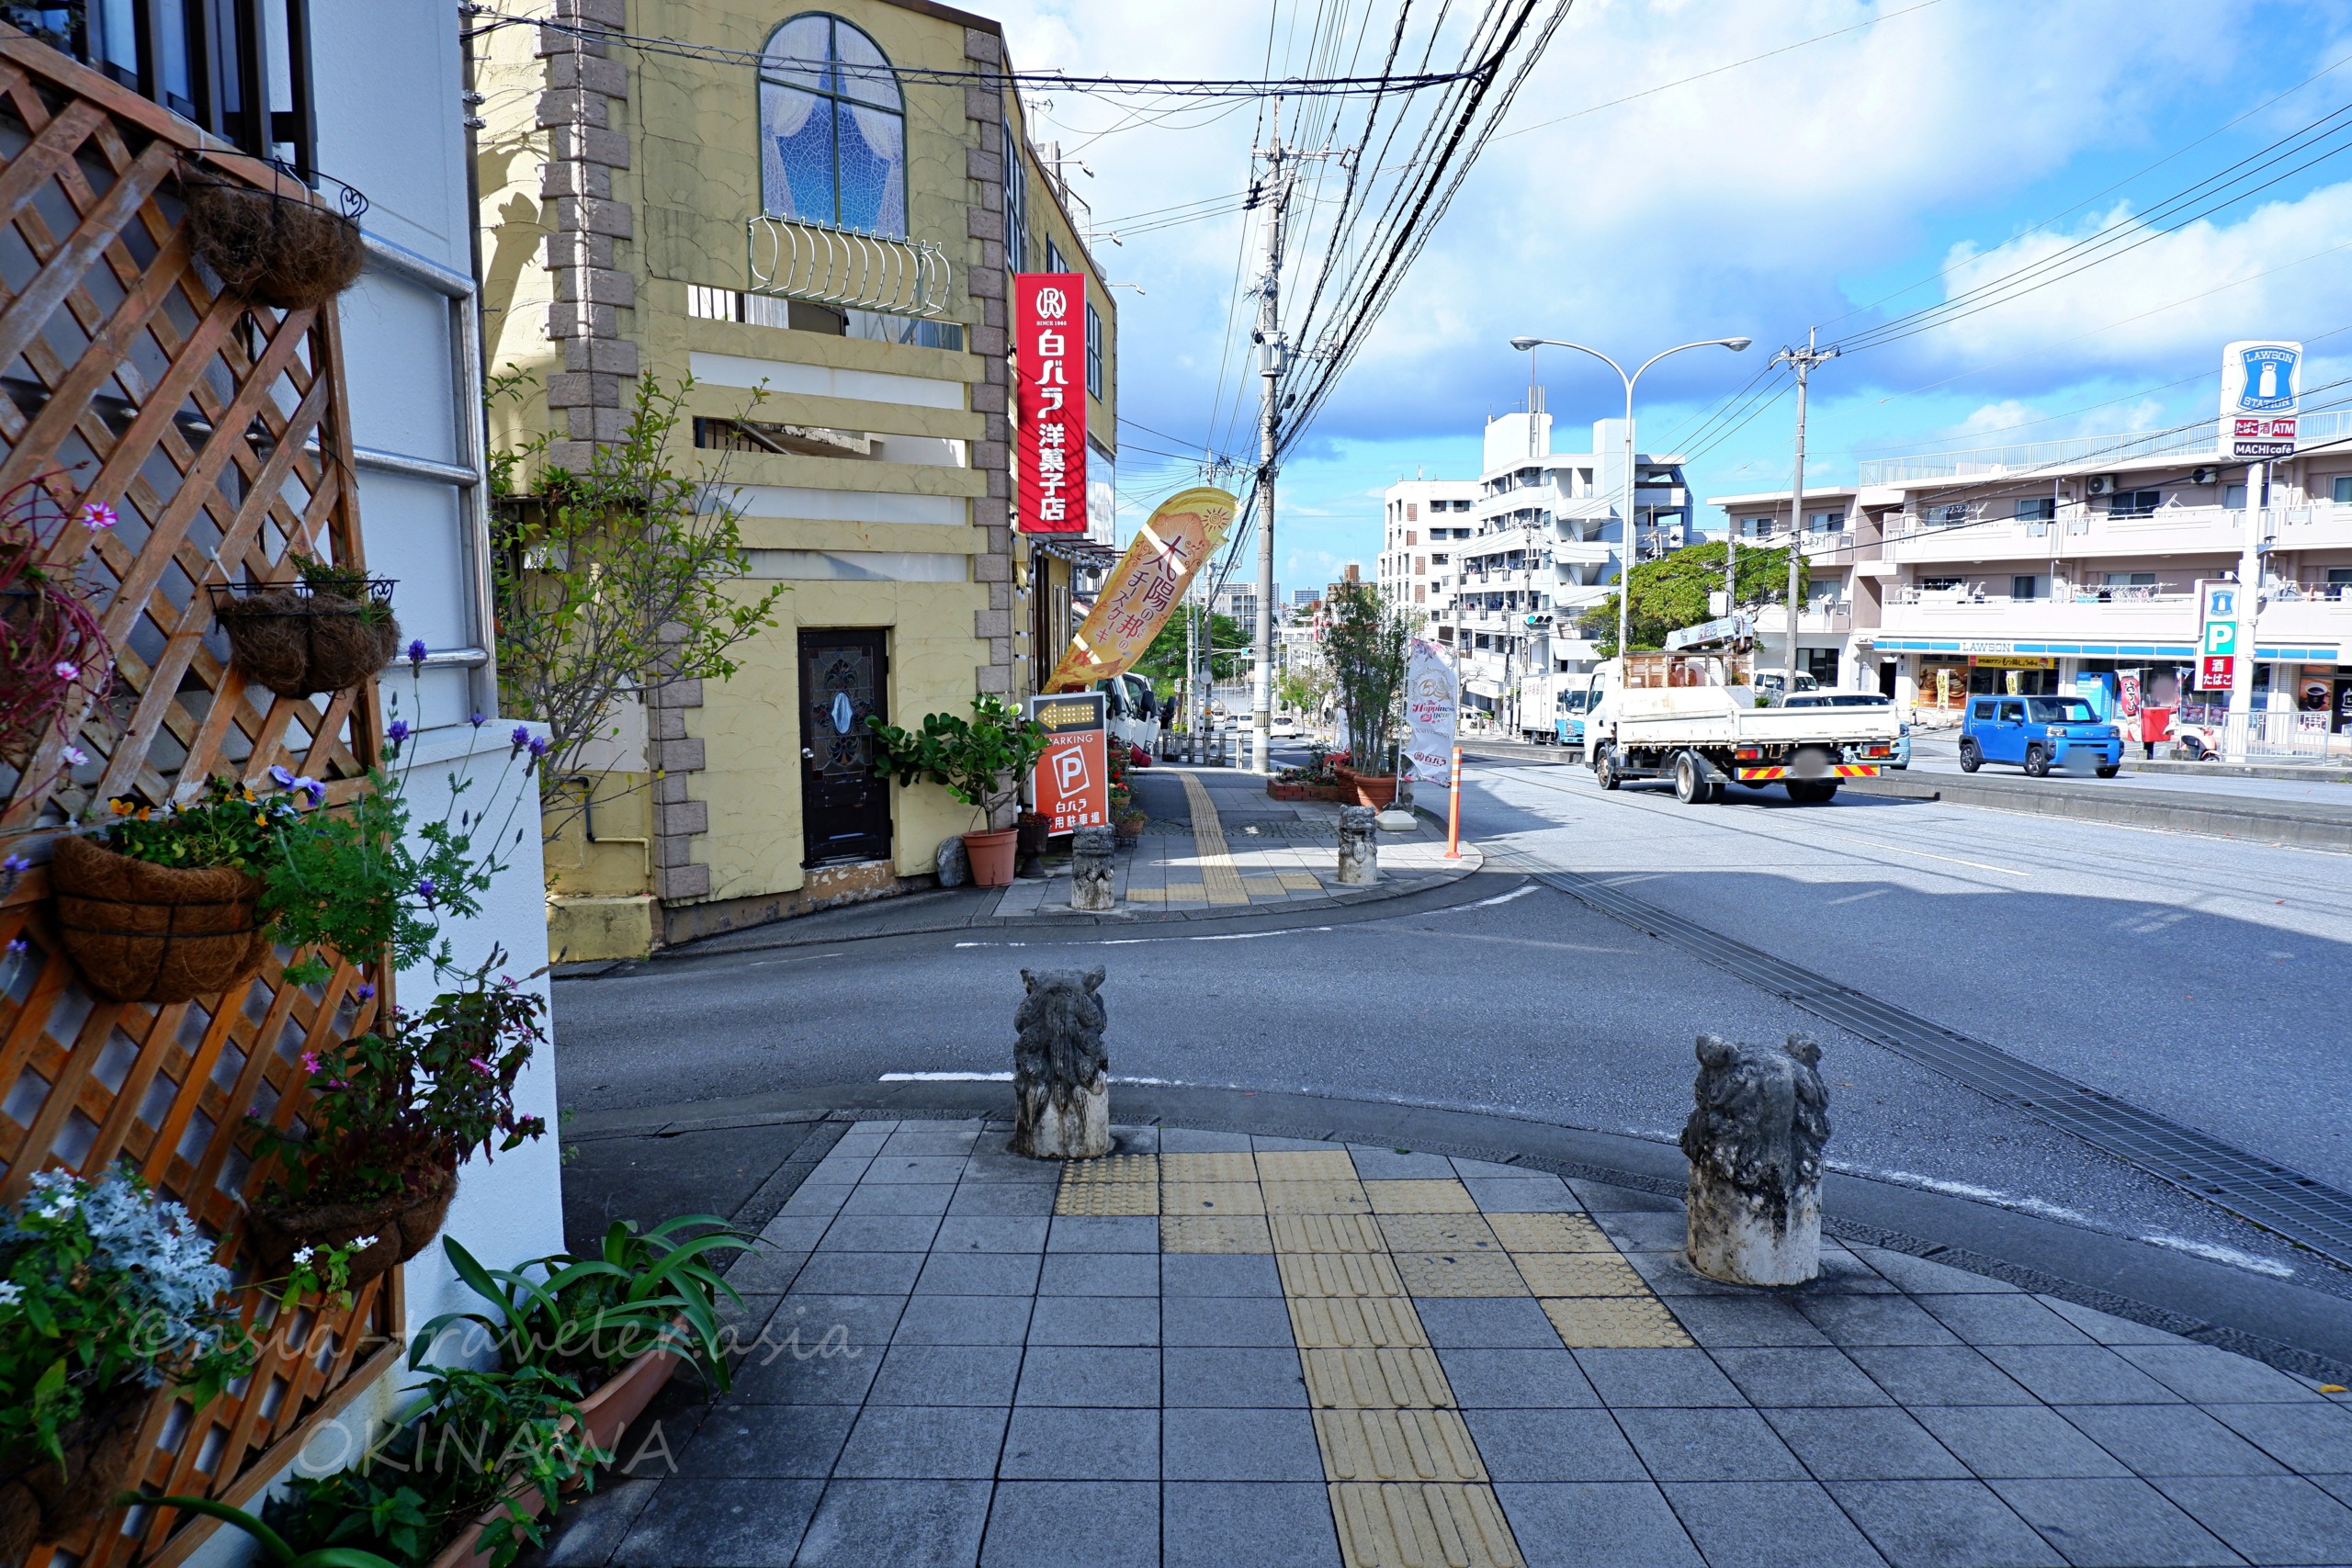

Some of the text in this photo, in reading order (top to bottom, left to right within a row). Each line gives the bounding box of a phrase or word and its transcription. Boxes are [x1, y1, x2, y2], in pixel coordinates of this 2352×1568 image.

[2245, 350, 2294, 363] LAWSON
[2243, 396, 2290, 409] STATION
[1035, 329, 1069, 521] 白バラ洋菓子店
[2235, 422, 2294, 434] たばこ 酒 ATM
[2235, 444, 2292, 455] MACHI café
[1096, 570, 1149, 643] チーズケーキ
[2208, 624, 2233, 652] P
[1962, 642, 2011, 652] LAWSON
[2211, 660, 2225, 672] 酒
[2203, 673, 2232, 685] たばこ
[1062, 757, 1082, 788] P
[1056, 797, 1087, 814] 白バラ
[1049, 811, 1100, 829] 用駐車場
